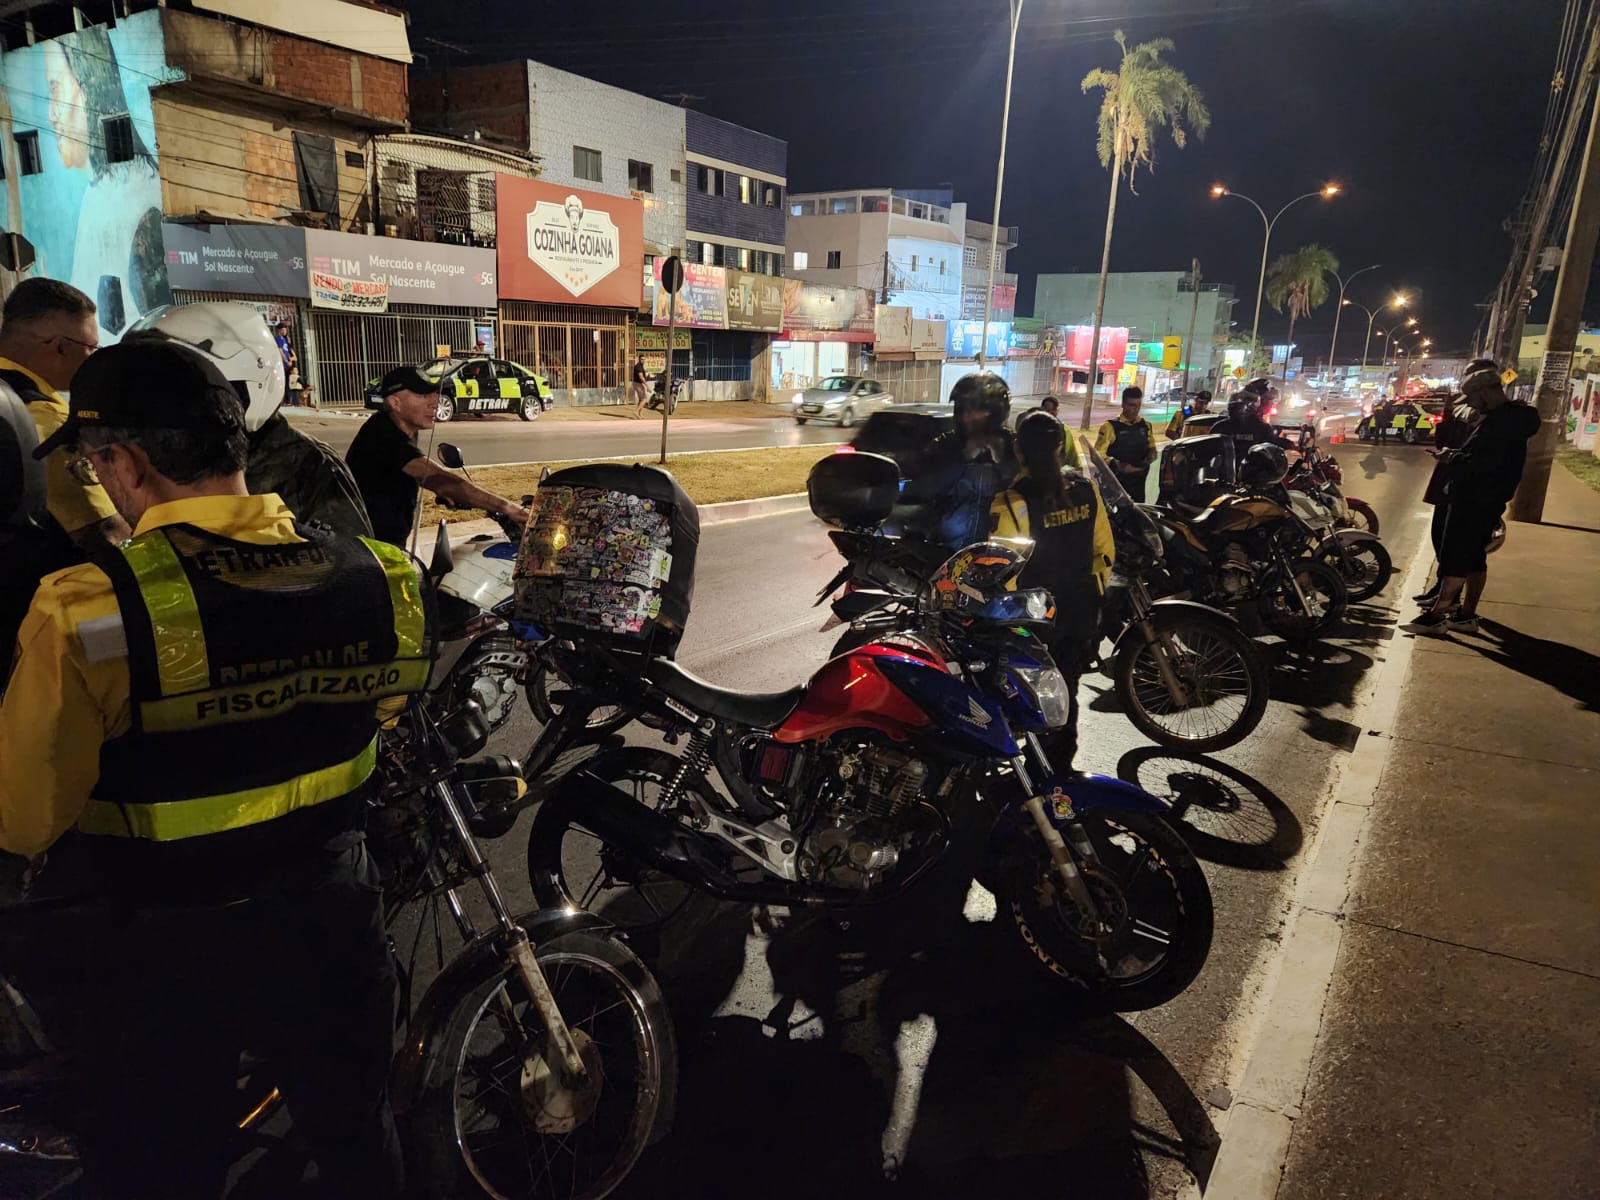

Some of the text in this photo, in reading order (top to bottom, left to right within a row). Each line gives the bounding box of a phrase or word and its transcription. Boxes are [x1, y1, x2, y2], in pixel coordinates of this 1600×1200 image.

[534, 228, 614, 259] COZINHA GOIANA
[179, 251, 199, 265] TIM
[202, 246, 279, 262] Mercado e Açougue
[204, 261, 255, 274] Sol Nascente
[292, 256, 304, 270] 5G
[331, 258, 361, 276] TIM
[368, 254, 465, 276] Mercado e Açougue
[312, 272, 343, 292] VENDO
[370, 273, 436, 289] Sol Nascente
[481, 271, 493, 286] 5G
[468, 398, 510, 411] DETRAN
[196, 668, 400, 720] FISCALIZAÇÃO
[958, 713, 988, 730] HONDA
